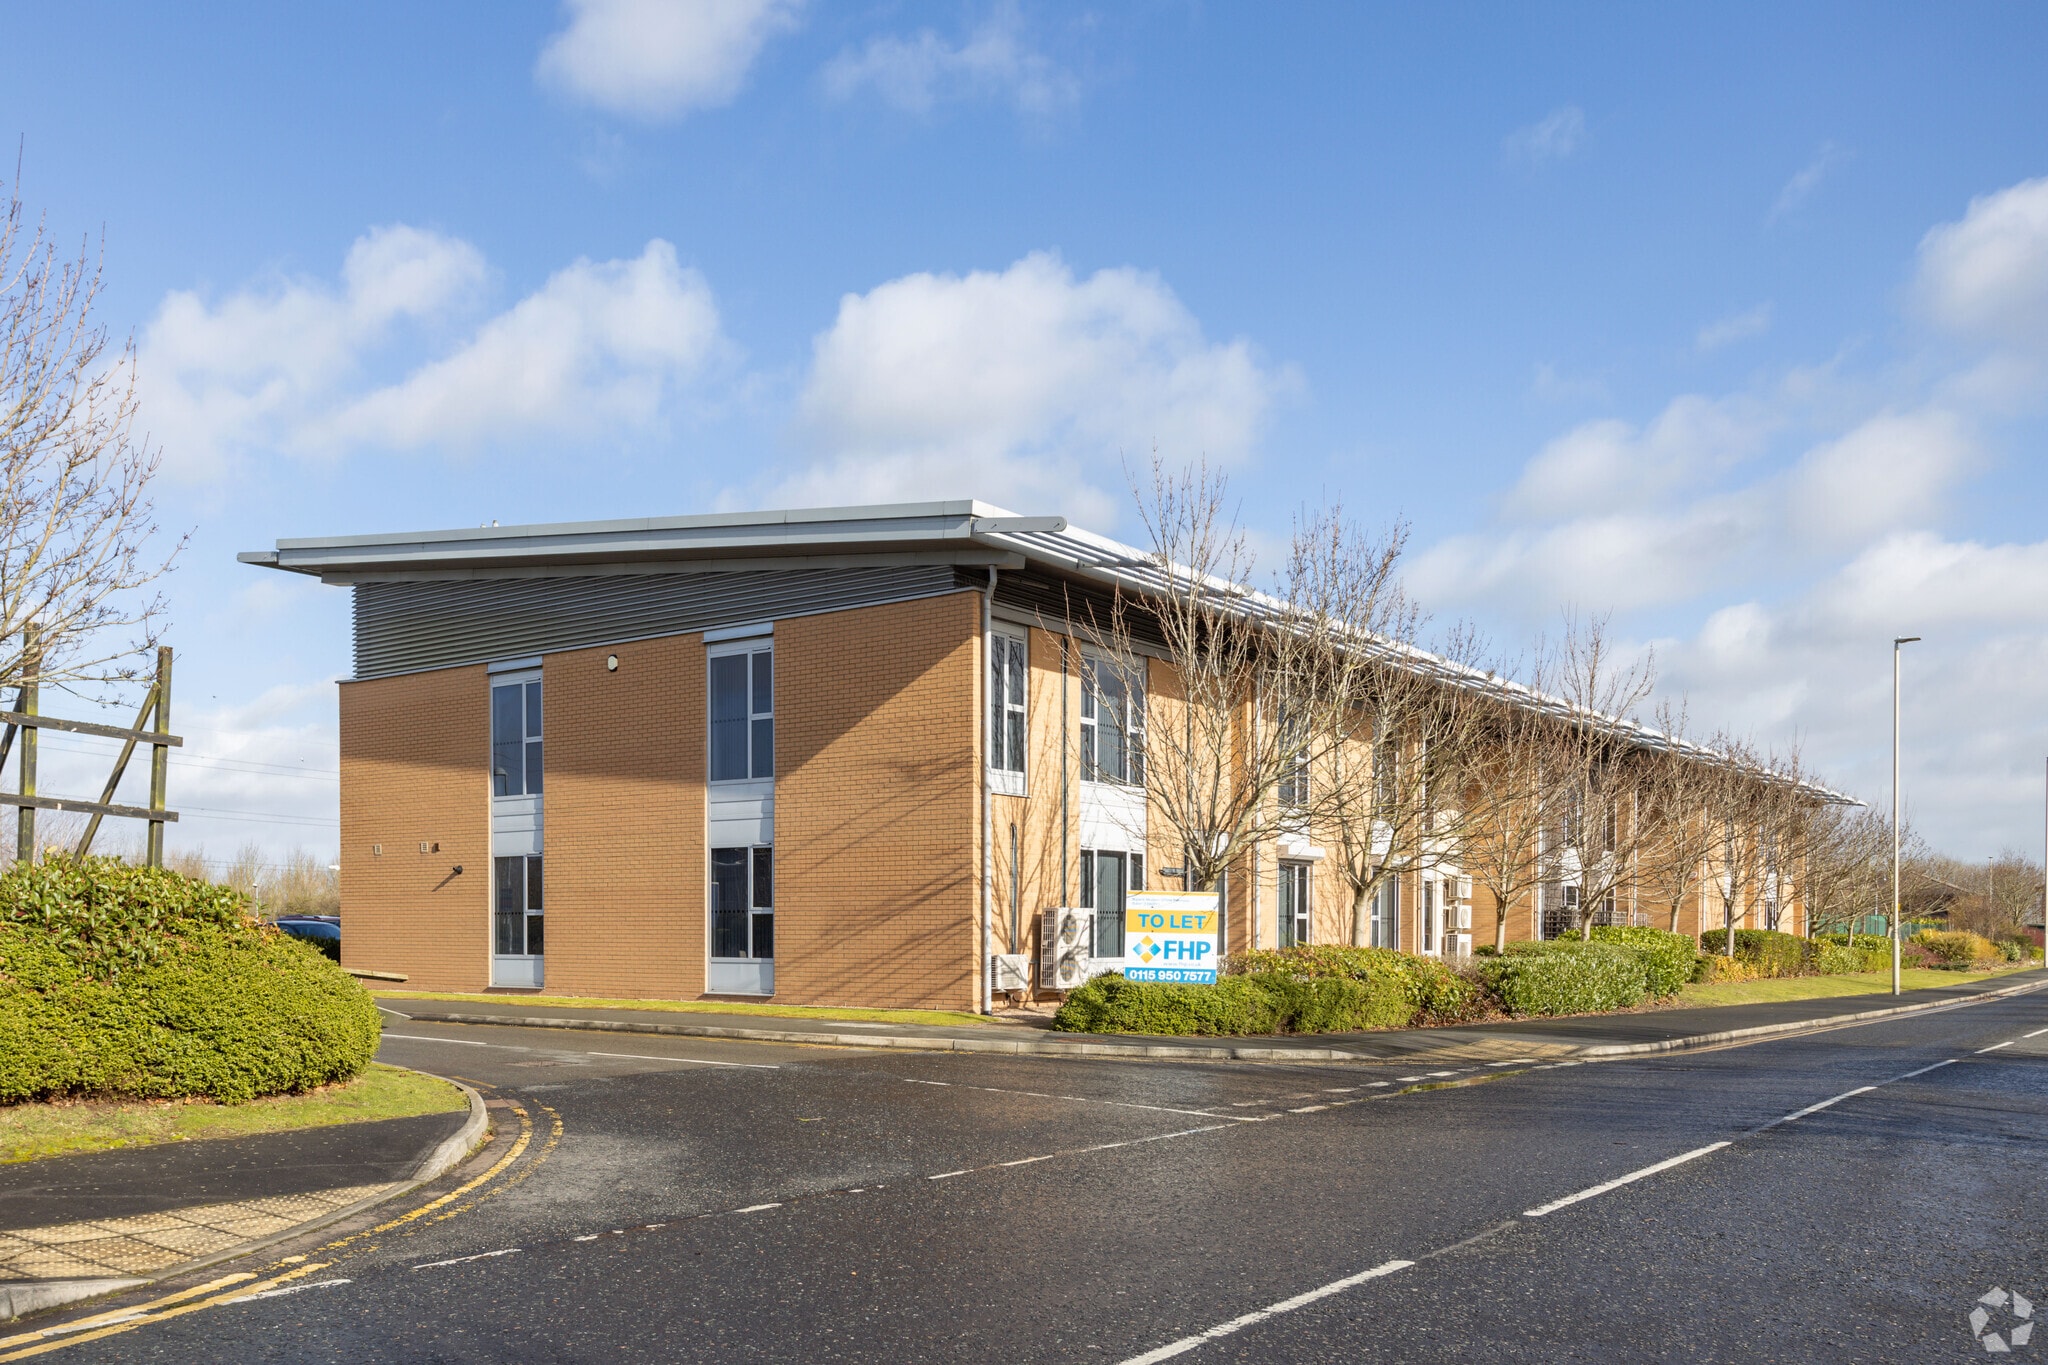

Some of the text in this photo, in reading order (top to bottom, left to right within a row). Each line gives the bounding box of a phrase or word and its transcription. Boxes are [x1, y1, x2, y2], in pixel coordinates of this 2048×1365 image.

[1138, 914, 1206, 929] TO LET
[1163, 940, 1211, 960] FHP
[1129, 969, 1211, 981] 0115 950 7577
